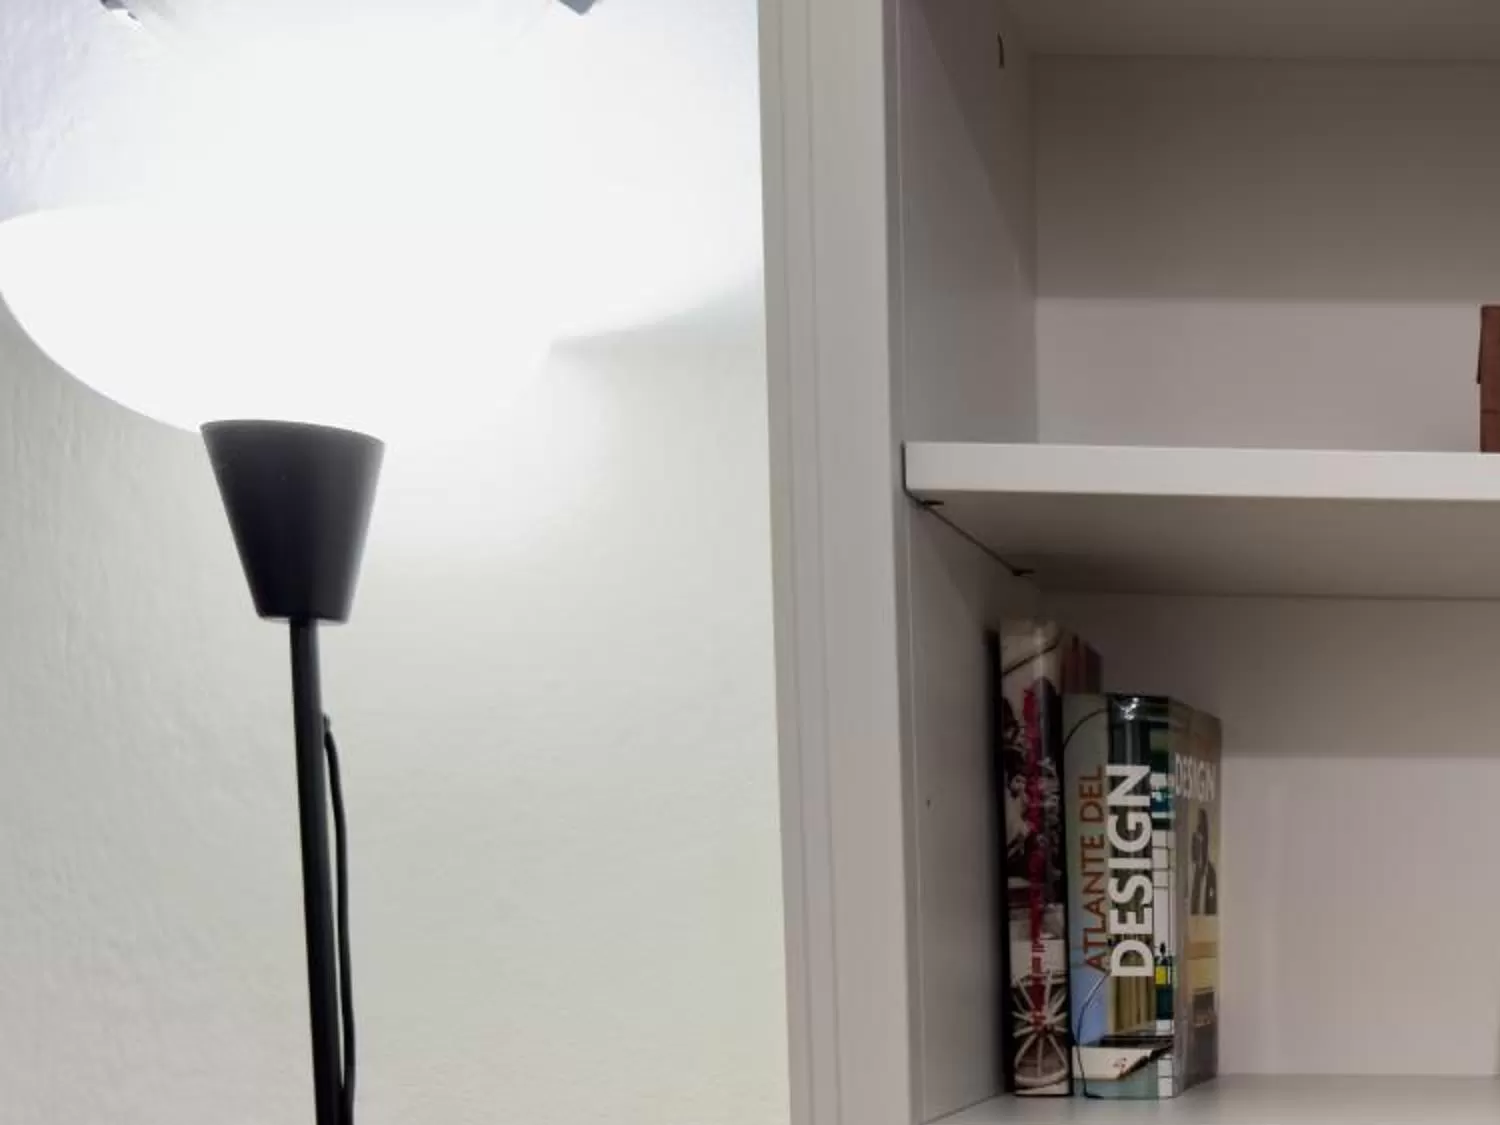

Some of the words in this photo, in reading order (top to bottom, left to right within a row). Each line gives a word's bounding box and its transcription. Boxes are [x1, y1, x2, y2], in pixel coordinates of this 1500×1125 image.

[1080, 765, 1103, 823] DEL
[1174, 751, 1217, 802] DESIGN
[1082, 832, 1107, 971] ATLANTE
[1107, 764, 1155, 977] DESIGN
